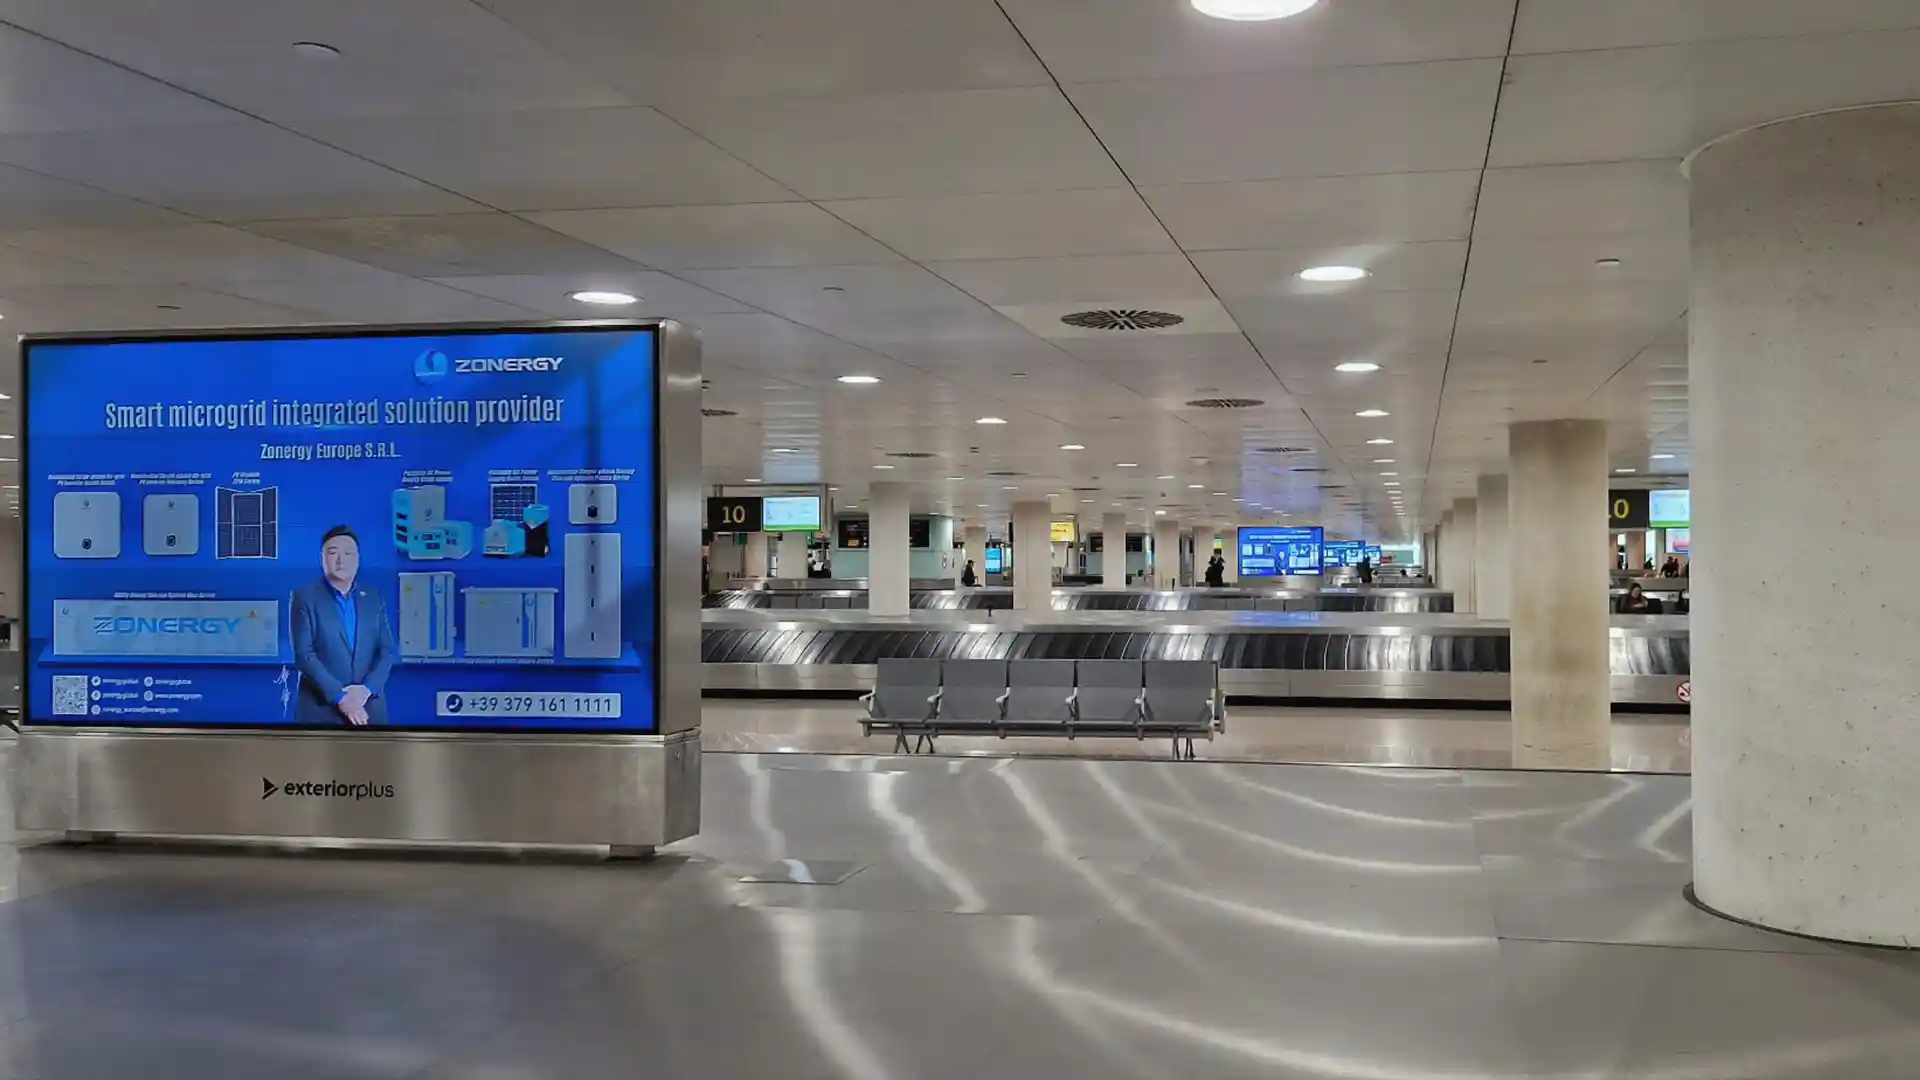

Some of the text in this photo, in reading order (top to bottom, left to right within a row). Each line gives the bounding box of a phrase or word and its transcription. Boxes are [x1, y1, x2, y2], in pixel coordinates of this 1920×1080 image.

[455, 357, 564, 374] ZONERGY
[105, 393, 565, 430] Smart microgrid integrated solution provider
[260, 440, 402, 461] Zonergy Europe S.R.L.
[721, 505, 747, 524] 10
[1608, 499, 1629, 518] 0
[93, 616, 241, 635] ZONERGY
[470, 696, 612, 713] +39 379 161 1111
[283, 779, 395, 801] exteriorplus
